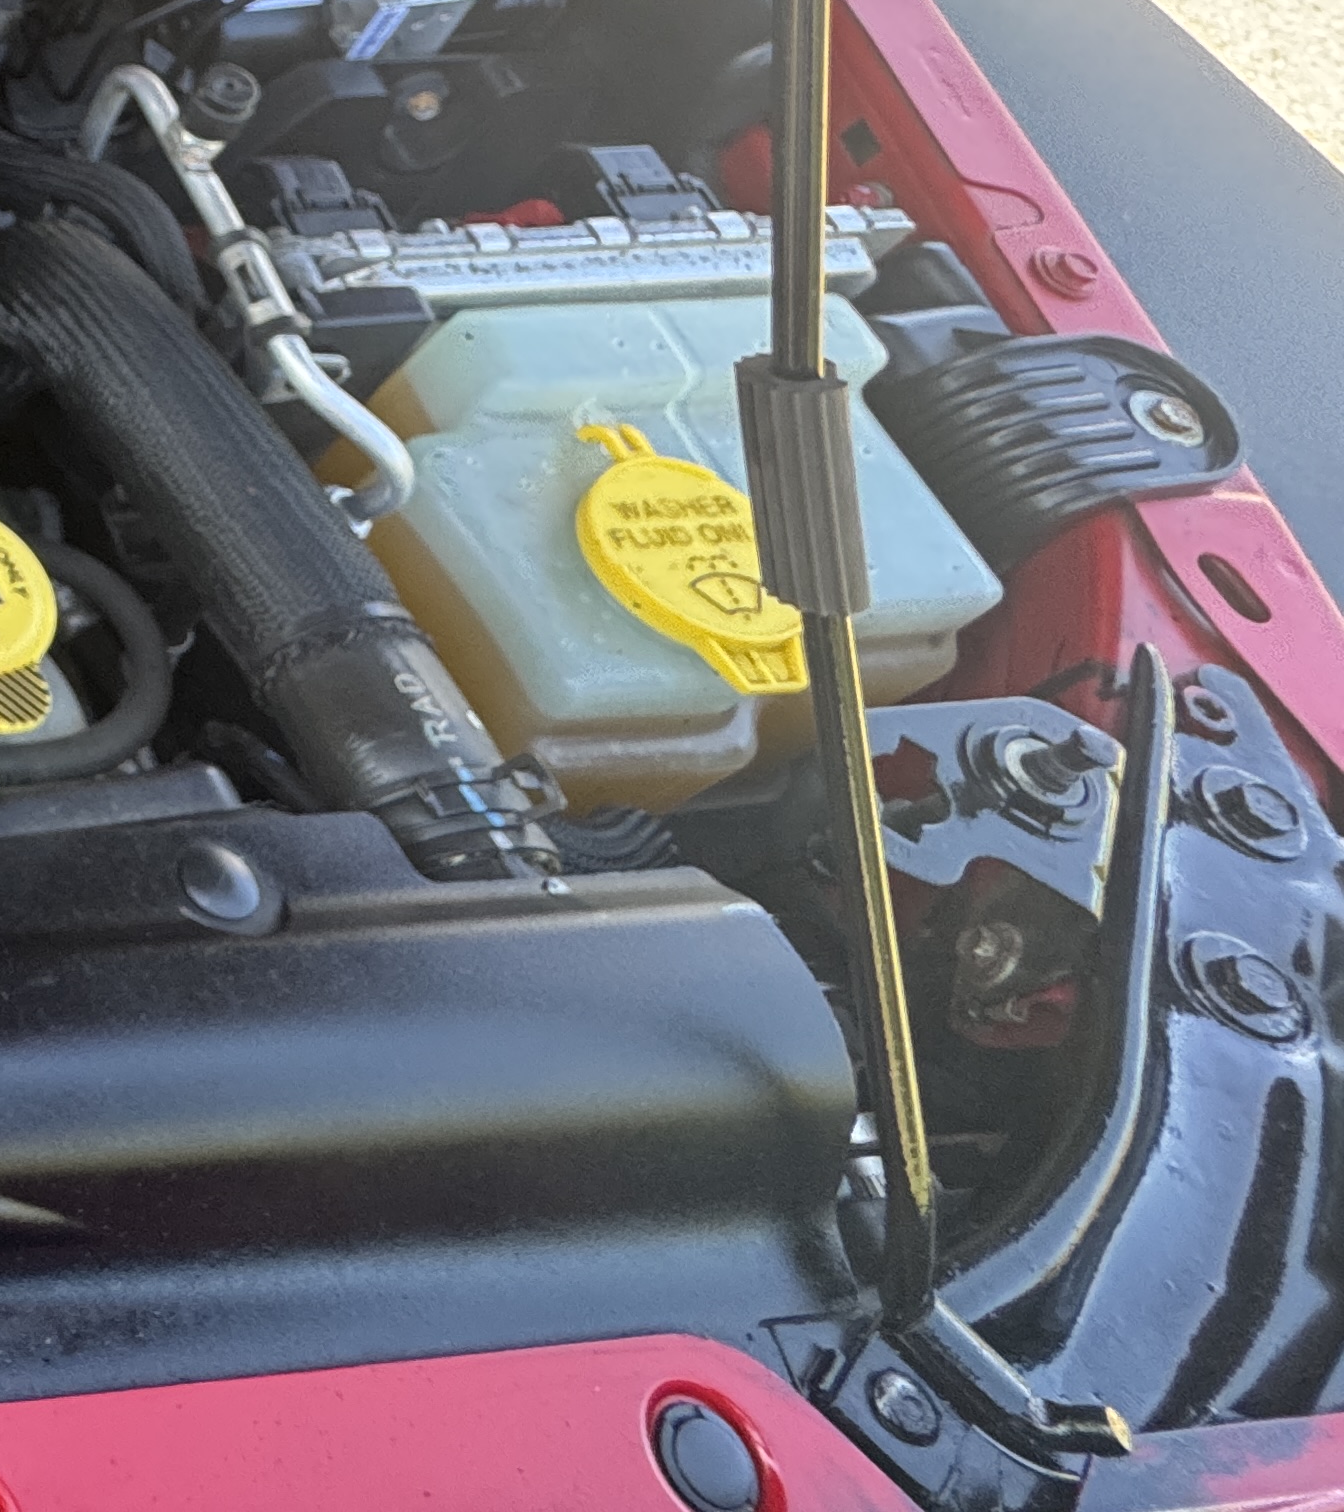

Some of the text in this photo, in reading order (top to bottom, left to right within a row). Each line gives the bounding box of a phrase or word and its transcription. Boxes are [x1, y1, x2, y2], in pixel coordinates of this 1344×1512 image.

[609, 495, 738, 521] WASHER
[606, 525, 693, 550] FLUID
[393, 672, 459, 750] RAD
